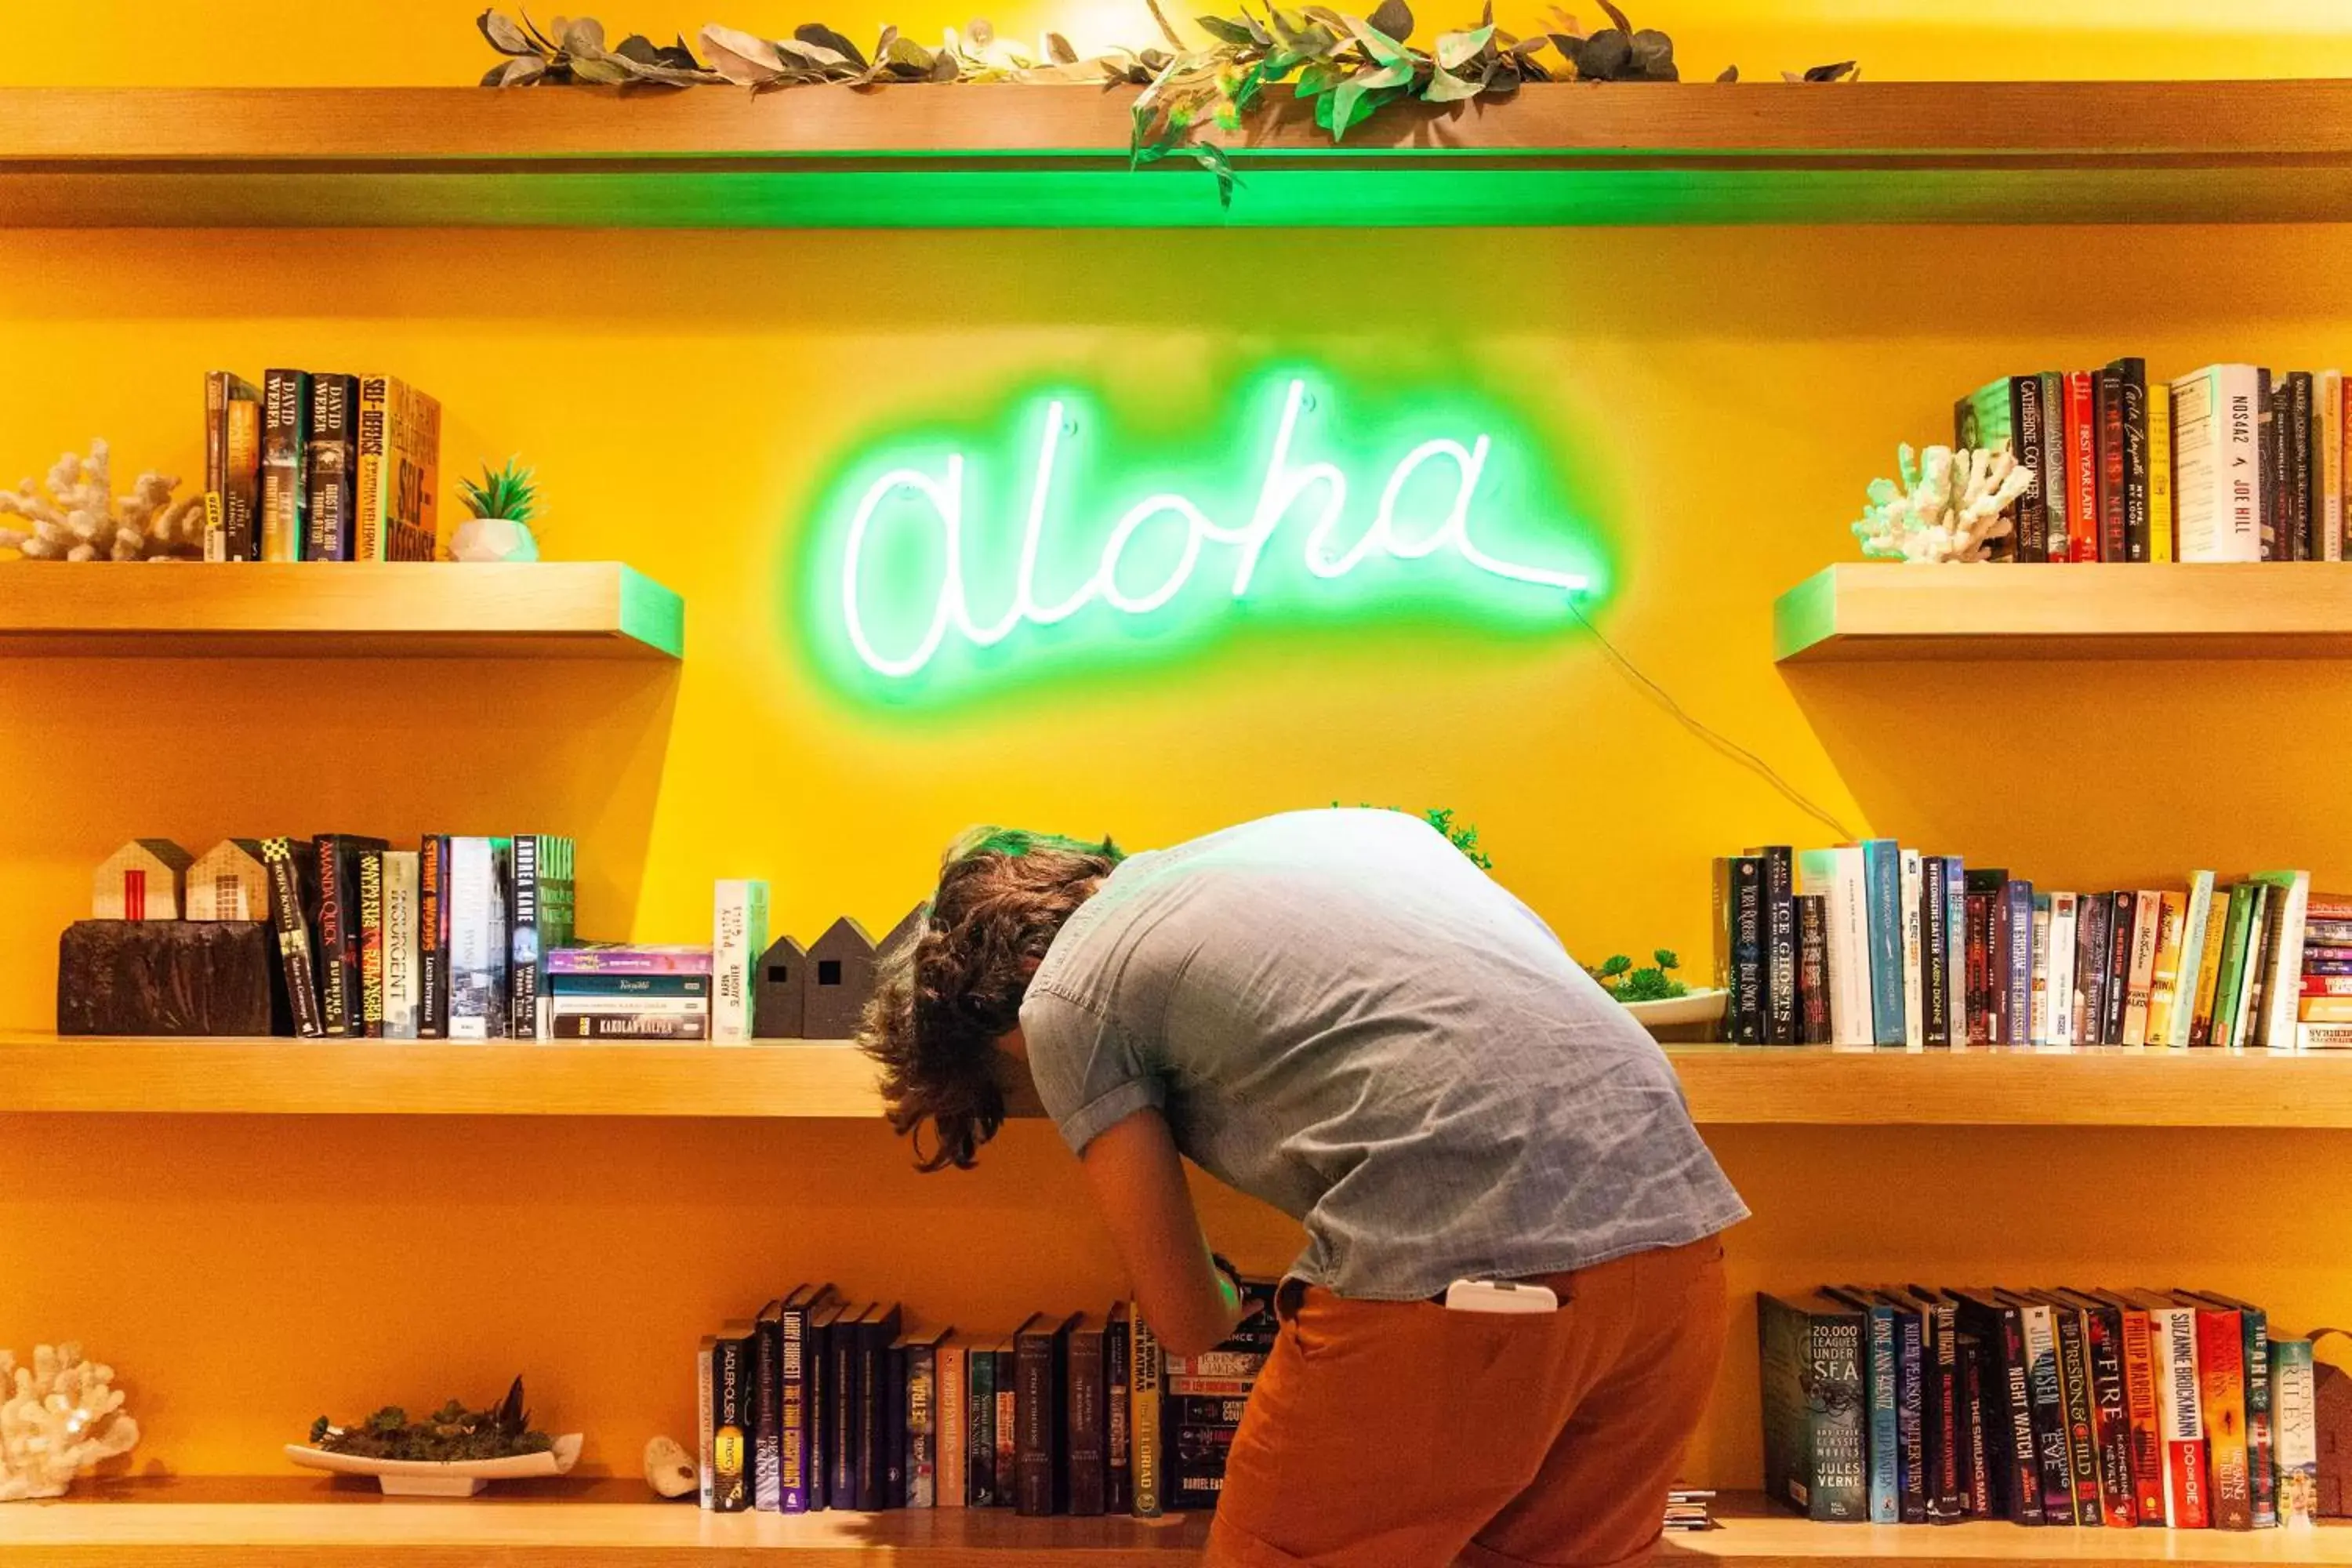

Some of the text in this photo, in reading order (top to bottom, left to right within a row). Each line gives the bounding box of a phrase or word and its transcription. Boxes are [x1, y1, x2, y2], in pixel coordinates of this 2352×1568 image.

[267, 377, 281, 429] WEBER
[281, 382, 296, 426] DAVID
[314, 382, 328, 433] WEBER
[328, 387, 343, 429] DAVID
[2020, 380, 2037, 442] CATHERINE
[2232, 396, 2250, 444] NOS4A2
[2081, 424, 2094, 520] FIRST YEAR LATIN
[2136, 485, 2144, 499] MY
[2234, 479, 2251, 534] JOE HILL
[318, 840, 338, 946] AMANDA QUICK
[361, 857, 371, 927] WILLIAMS
[422, 840, 437, 950] STUART WOODS
[517, 840, 535, 922] ANDREA KANE
[1740, 884, 1758, 908] NORA
[390, 890, 408, 1000] INSURGENT
[1777, 901, 1791, 1022] ICE GHOSTS
[1931, 921, 1940, 954] DATTER
[324, 988, 334, 1022] LAMP
[330, 960, 342, 1014] BURNING
[369, 949, 381, 1021] STRANGER
[720, 975, 730, 996] KARIN
[730, 964, 740, 1007] SLAUGHTER
[1740, 963, 1758, 1012] BLUE SMOKE
[1932, 957, 1943, 1025] KAREN DIONNE
[784, 1311, 800, 1380] LARRY BURKETT
[1145, 1345, 1156, 1378] RINGO
[1813, 1337, 1857, 1348] LEAGUES
[1813, 1348, 1854, 1359] UNDER
[1874, 1316, 1894, 1410] JAYNE ANN KRENTZ
[1904, 1322, 1922, 1410] RIDLEY PEARSON
[1938, 1330, 1956, 1365] HIGGINS
[2031, 1327, 2060, 1405] JOHANSEN
[2251, 1324, 2268, 1389] THE ARK
[724, 1349, 736, 1425] ADLER-OLSEN
[1813, 1360, 1859, 1381] SEA
[2008, 1366, 2028, 1407] NIGHT
[2065, 1339, 2085, 1405] PRESTON
[2098, 1329, 2122, 1423] THE FIRE
[2125, 1318, 2153, 1419] PHILLIP MARGOLIN
[2171, 1313, 2198, 1438] SUZANNE BROCKMANN
[2071, 1406, 2085, 1421] &
[2282, 1362, 2301, 1439] RILEY
[723, 1436, 735, 1471] mercy
[1817, 1436, 1859, 1446] CLASSIC
[1817, 1447, 1859, 1457] NOVELS
[1907, 1420, 1922, 1494] KILLER VIEW
[1970, 1397, 1987, 1512] THE SMILING MAN
[2013, 1411, 2034, 1459] WATCH
[2041, 1432, 2060, 1471] EVE
[2055, 1427, 2070, 1488] HUNTING
[2183, 1443, 2195, 1461] DO
[1817, 1462, 1860, 1475] JULES
[1817, 1475, 1860, 1487] VERNE
[2106, 1444, 2118, 1494] NEVILLE
[2117, 1433, 2129, 1501] KATHERINE
[2185, 1481, 2198, 1504] DIE
[2219, 1463, 2234, 1500] RULES
